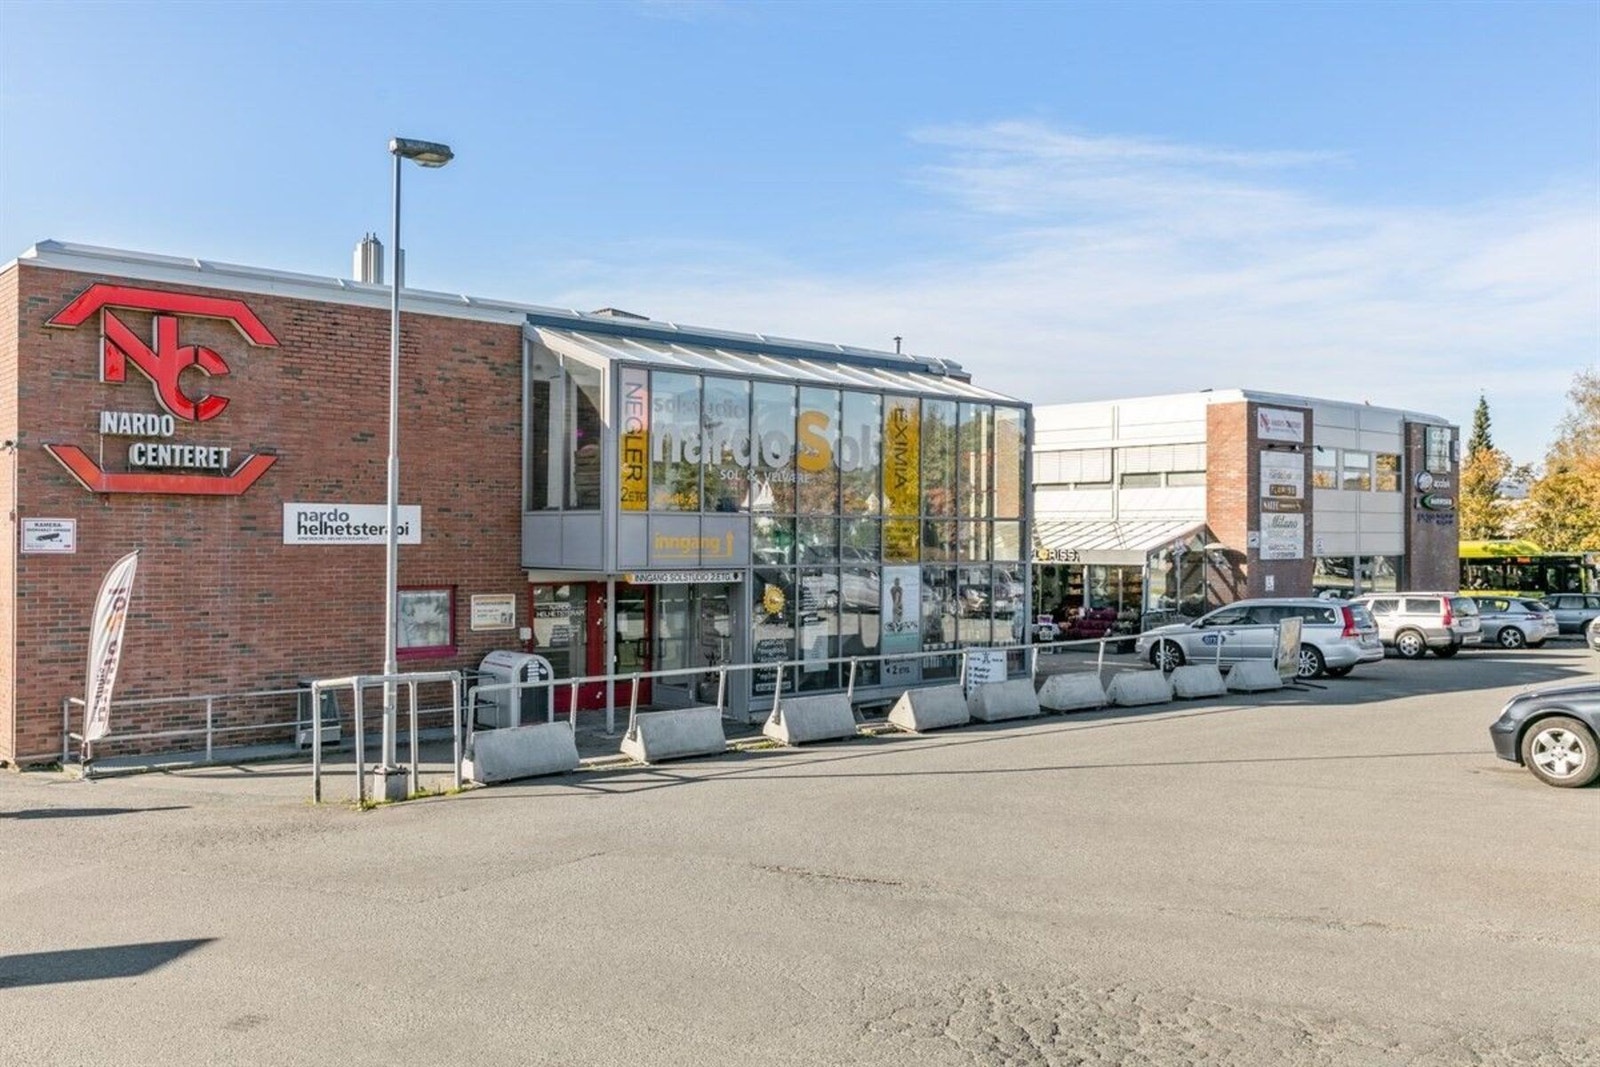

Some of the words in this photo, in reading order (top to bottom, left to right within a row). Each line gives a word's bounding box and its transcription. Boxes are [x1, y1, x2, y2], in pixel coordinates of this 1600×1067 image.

[100, 411, 174, 437] NARDO
[624, 382, 644, 482] NEGLER
[129, 443, 231, 468] CENTERET
[894, 407, 908, 489] EXIMIA
[720, 470, 741, 480] SOL
[297, 508, 350, 522] nardo
[297, 520, 410, 536] helhetsterpi
[654, 532, 720, 555] inngang
[635, 572, 668, 581] INNGANG
[669, 571, 708, 581] SOLSTUDIO
